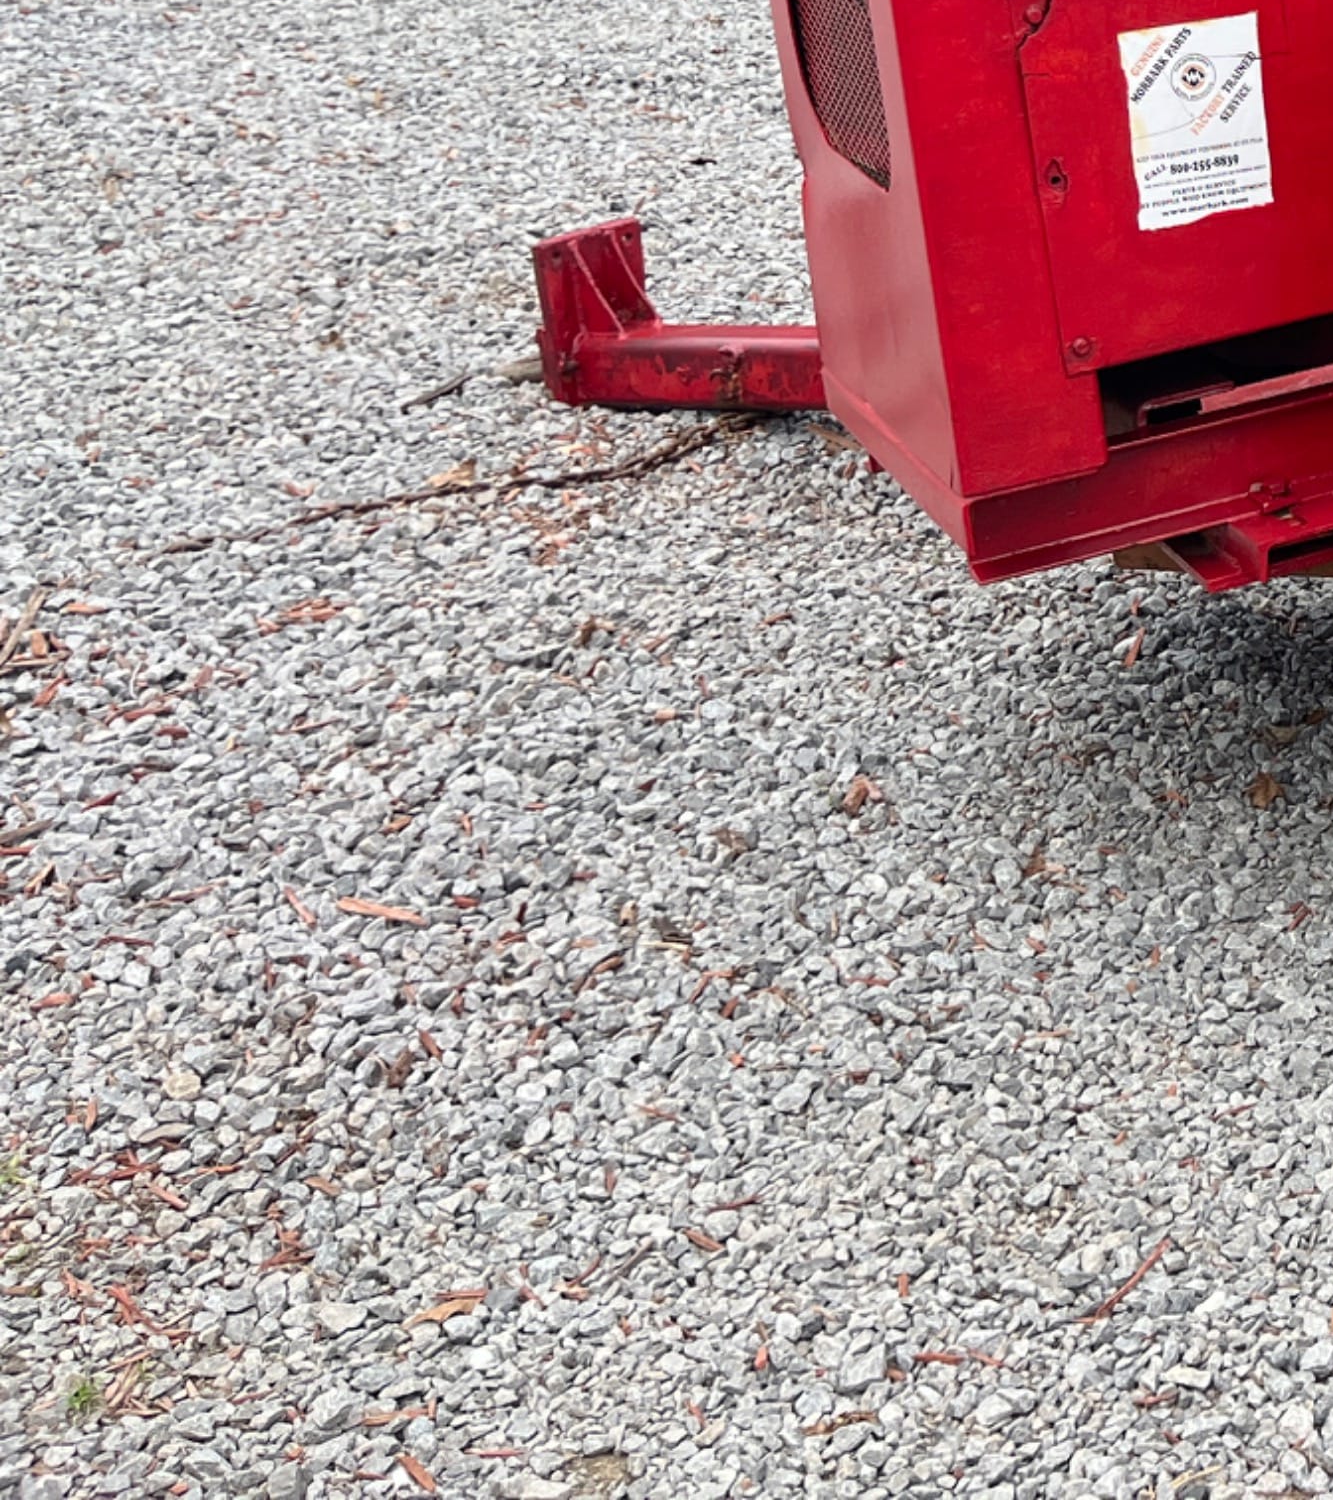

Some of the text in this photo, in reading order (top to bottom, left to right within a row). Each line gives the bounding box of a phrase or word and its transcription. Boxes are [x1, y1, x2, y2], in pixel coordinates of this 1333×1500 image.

[1130, 27, 1192, 105] MORBARK PARTS
[1222, 51, 1257, 94] TRAINED
[1220, 83, 1252, 123] SERVICE
